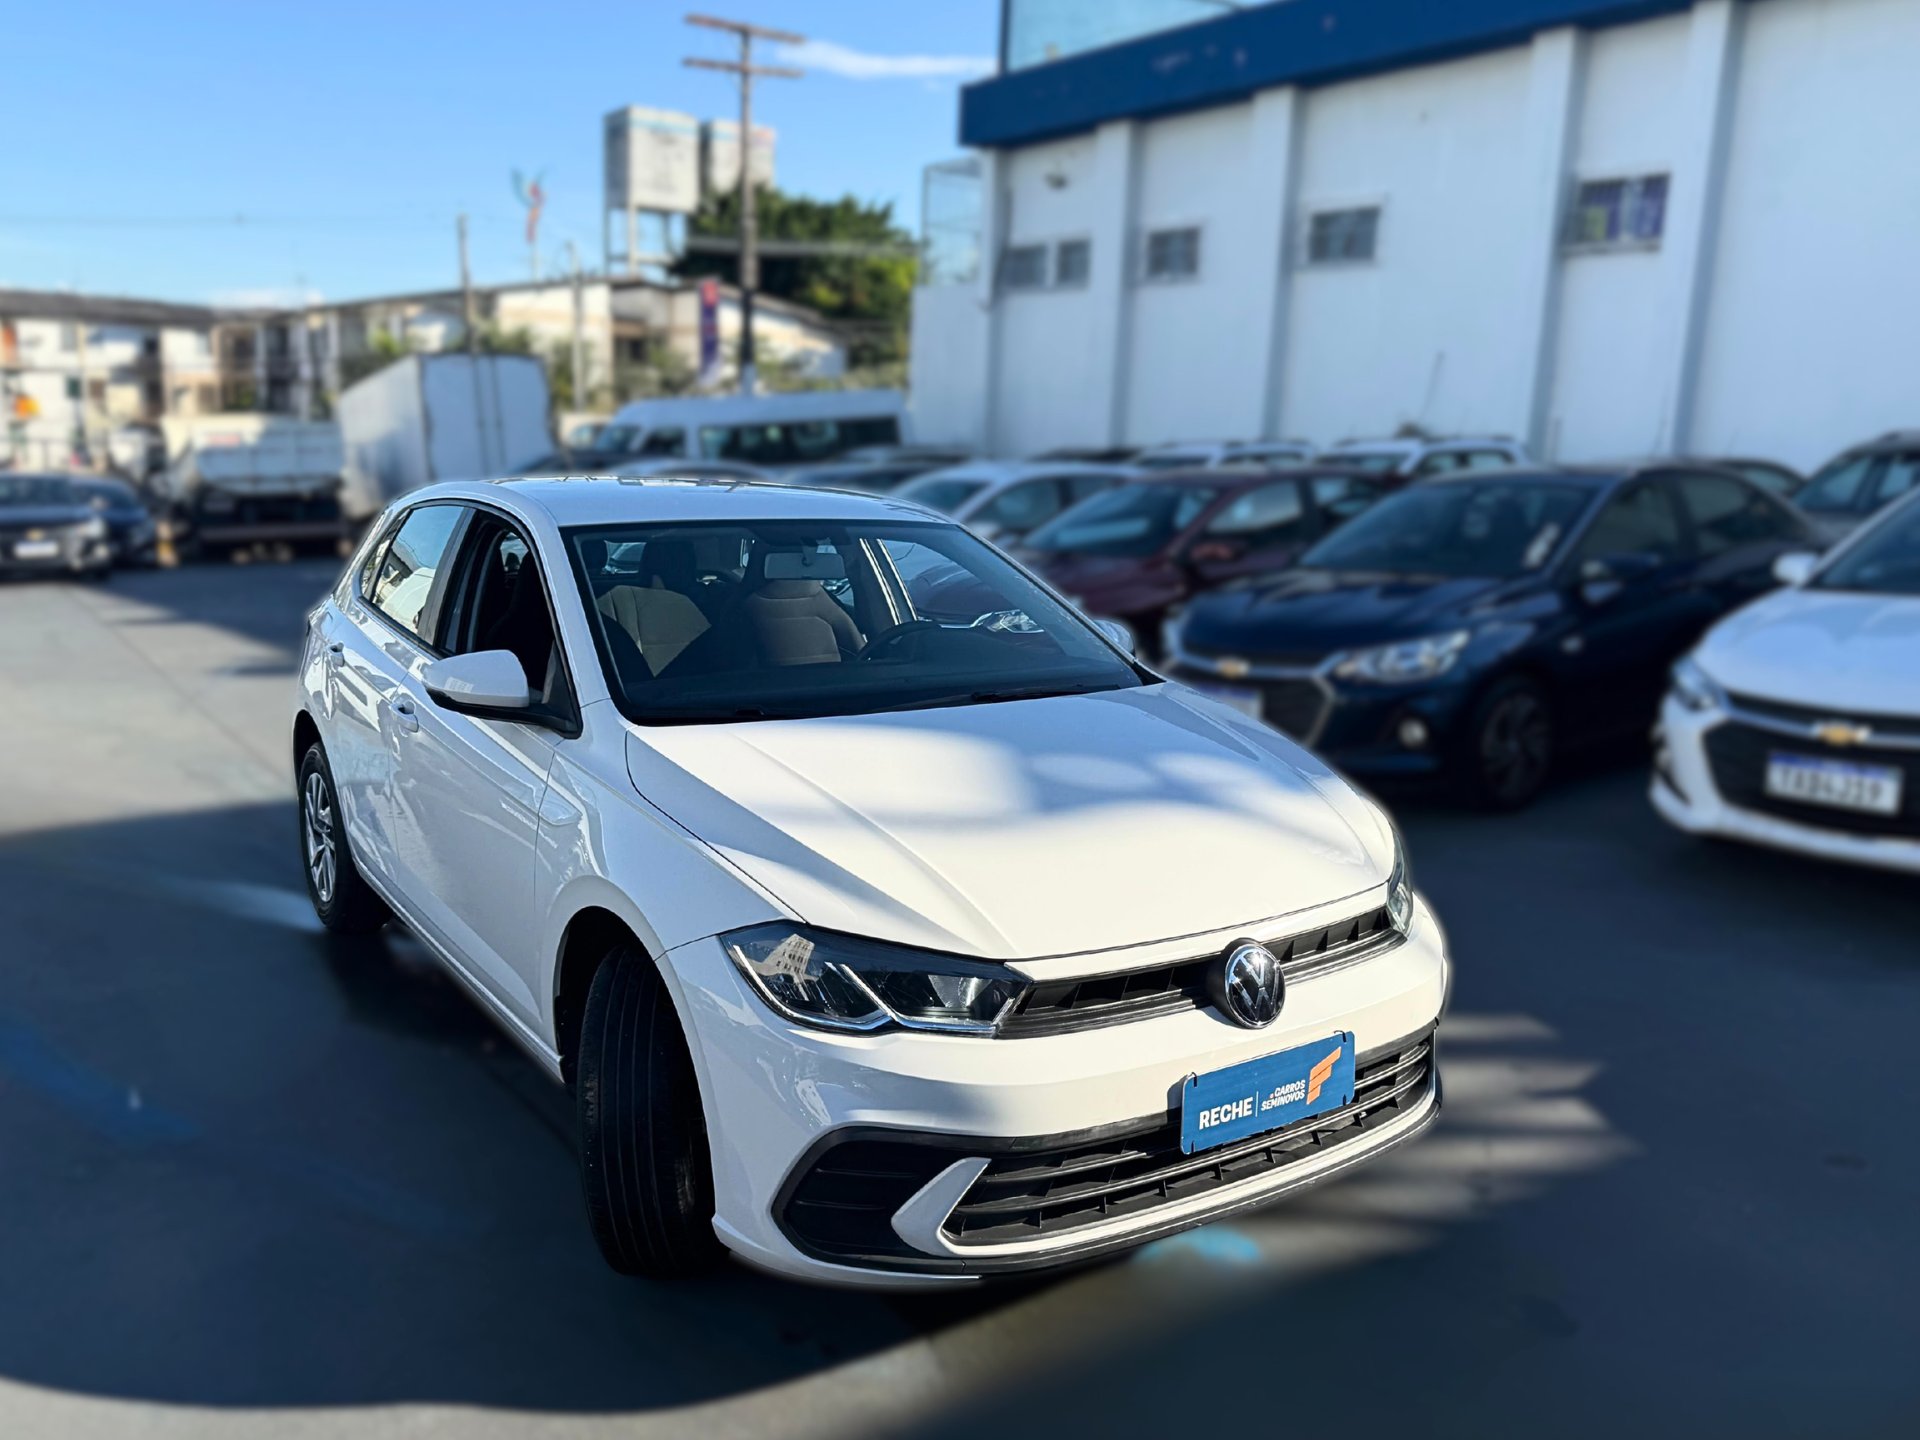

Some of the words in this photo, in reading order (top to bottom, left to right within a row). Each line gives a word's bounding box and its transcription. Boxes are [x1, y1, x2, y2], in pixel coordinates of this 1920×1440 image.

[1274, 1079, 1306, 1098] CARROS
[1261, 1089, 1305, 1111] SEMINOVOS
[1199, 1096, 1253, 1130] RECHE
